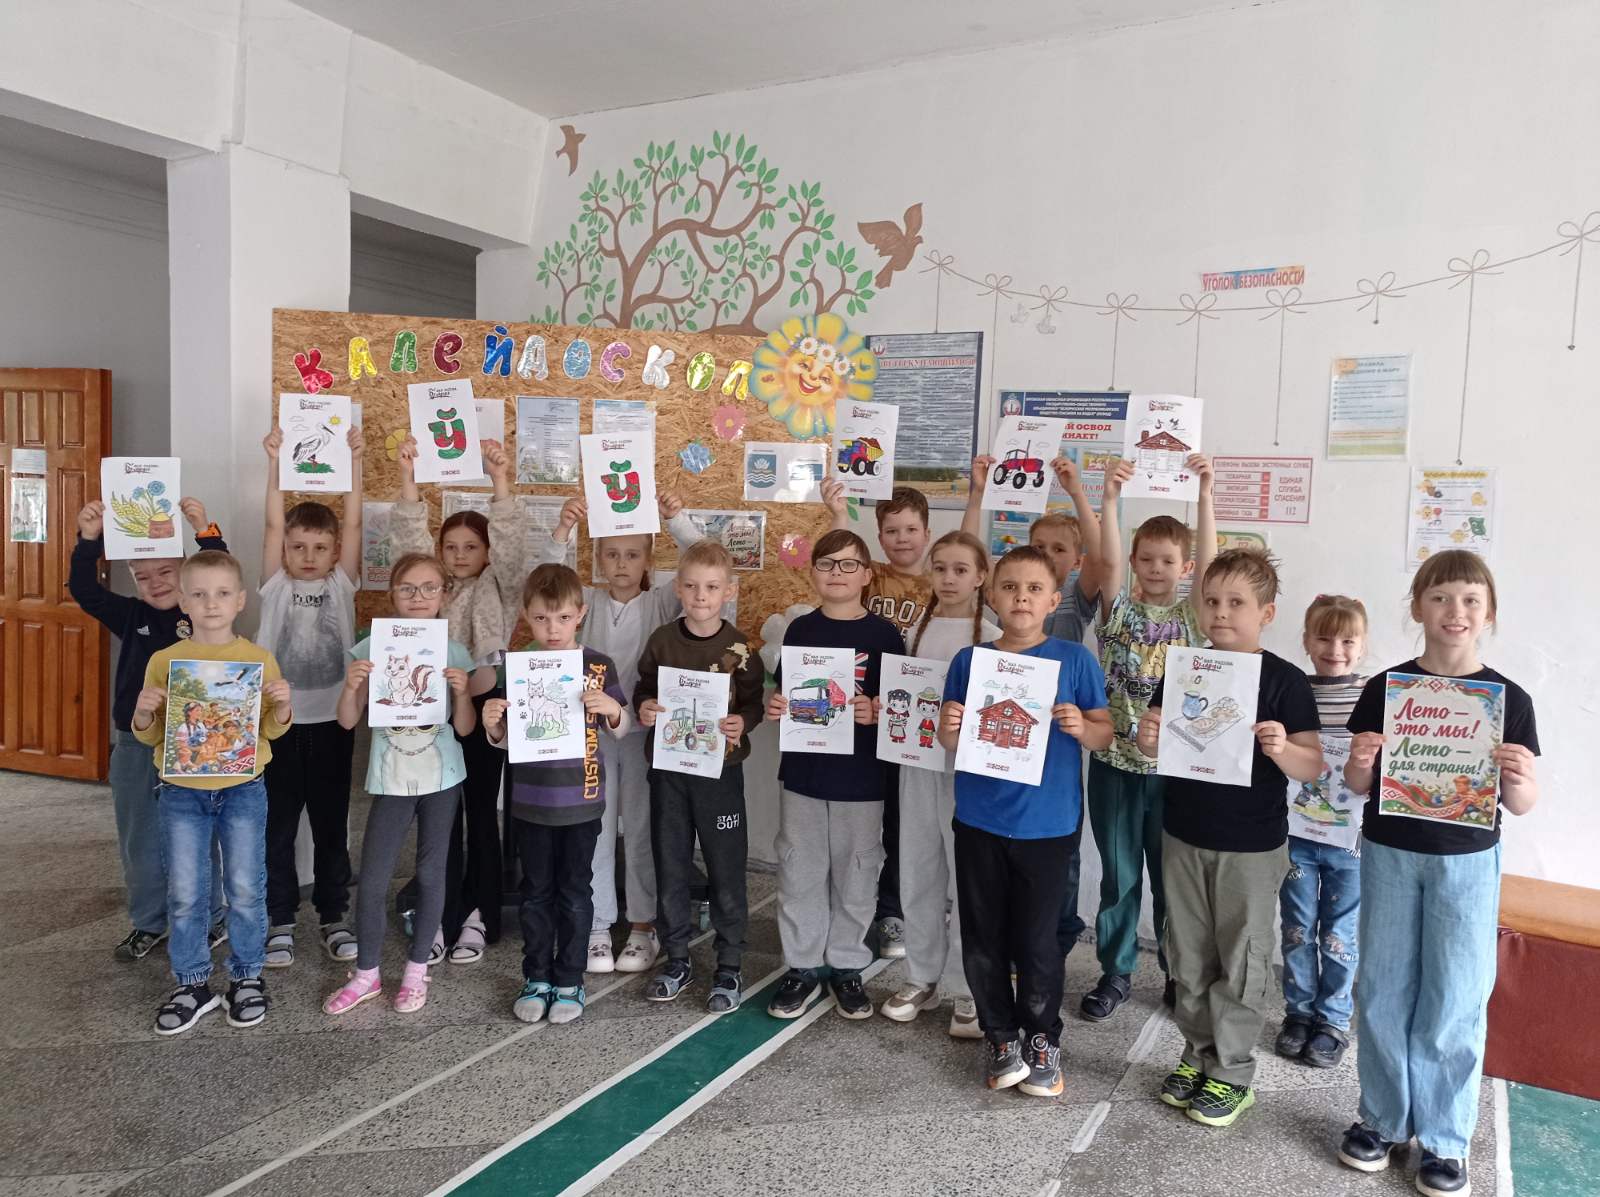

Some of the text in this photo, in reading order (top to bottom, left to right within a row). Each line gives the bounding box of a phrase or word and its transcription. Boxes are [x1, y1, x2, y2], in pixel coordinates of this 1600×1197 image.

[1203, 269, 1305, 291] УГОЛОК БЕЗОПАСНОСТИ
[1076, 423, 1112, 432] ОСВОД
[1274, 494, 1305, 502] СПАСЕНИЯ
[1278, 485, 1302, 493] СЛУЖБА
[1393, 697, 1450, 720] Лето
[1393, 720, 1481, 739] это мы!
[1390, 737, 1452, 758] Лето
[583, 727, 600, 800] CUSTOM
[1387, 759, 1485, 777] для страны!
[717, 814, 737, 822] STAY
[717, 820, 738, 830] OUT
